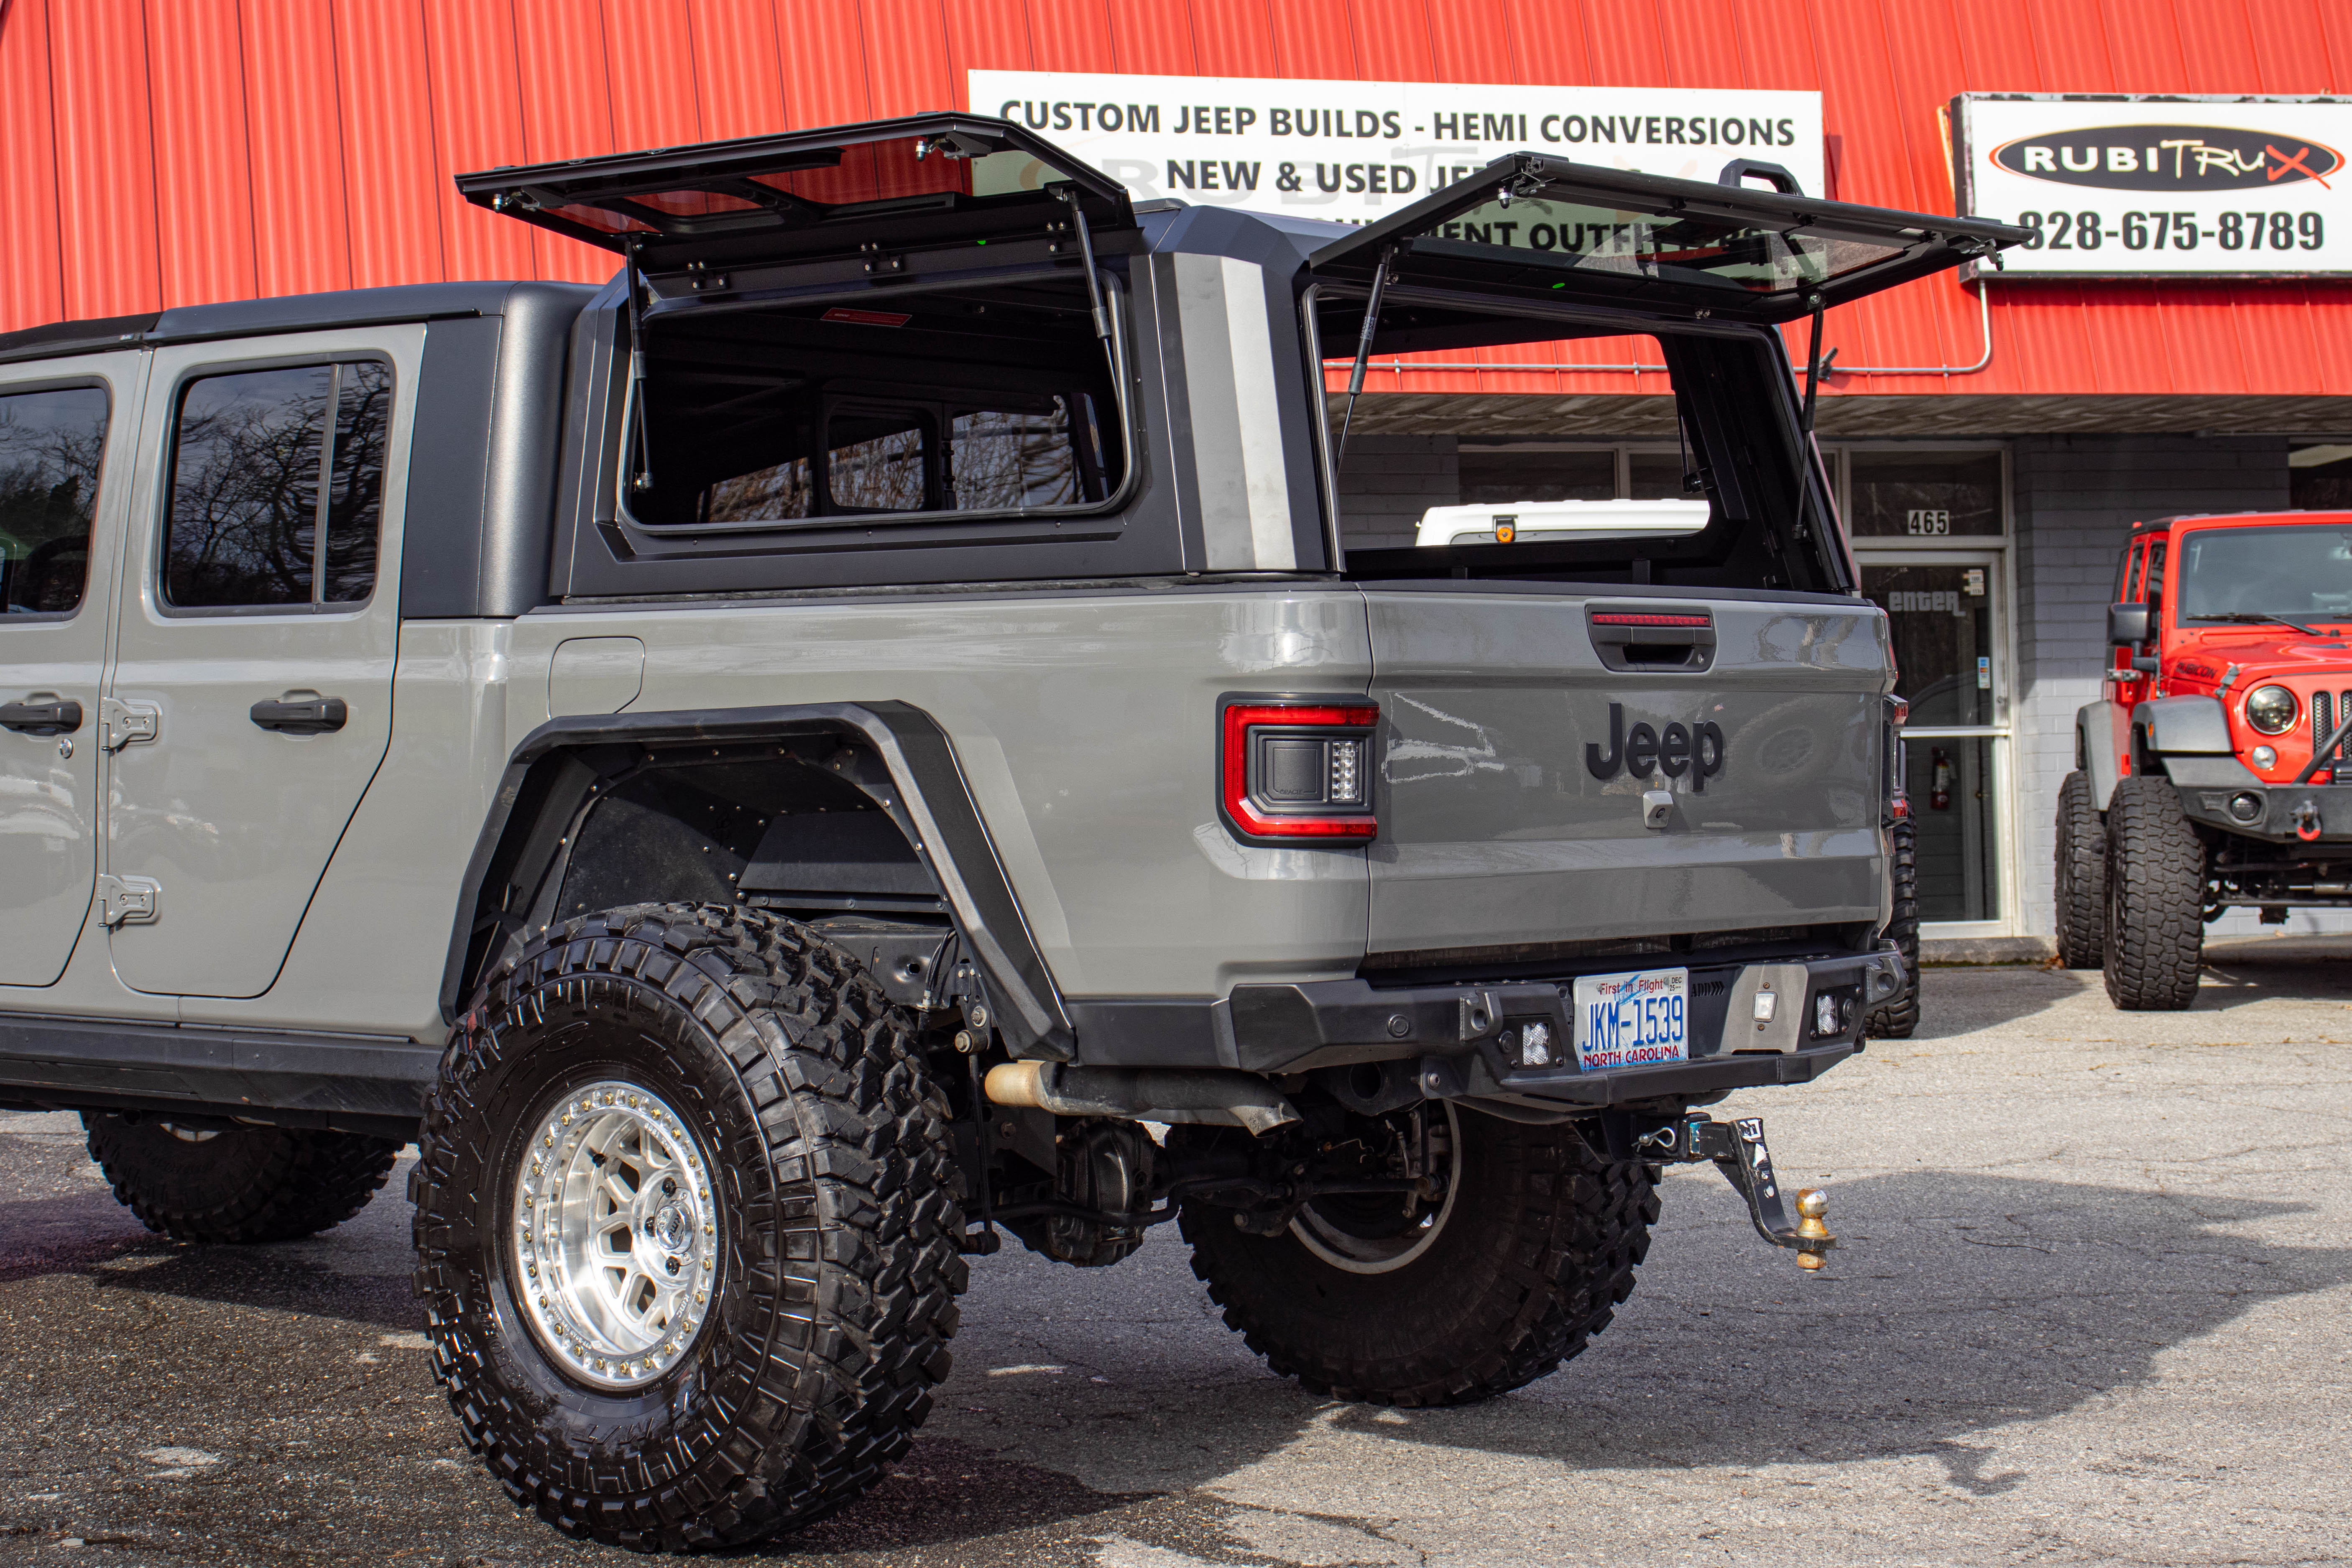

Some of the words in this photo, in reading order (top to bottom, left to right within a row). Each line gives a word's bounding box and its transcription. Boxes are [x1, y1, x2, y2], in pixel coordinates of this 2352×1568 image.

[1001, 100, 1159, 133] CUSTOM
[1174, 105, 1256, 135] JEEP
[1271, 108, 1401, 139] BUILDS
[1434, 112, 1527, 141] HEMI
[1541, 115, 1795, 146] CONVERSIONS
[1167, 160, 1261, 191] NEW
[1276, 161, 1302, 192] &
[1316, 163, 1417, 193] USED
[2019, 211, 2324, 250] 828-675-8789
[1910, 511, 1947, 534] 465
[1586, 702, 1724, 792] Jeep
[1599, 983, 1620, 995] First
[1625, 981, 1633, 993] in
[1639, 978, 1663, 993] Flight
[1582, 995, 1683, 1051] JKM-1539
[1584, 1051, 1621, 1068] NORTH
[1625, 1045, 1679, 1063] CAROLINA
